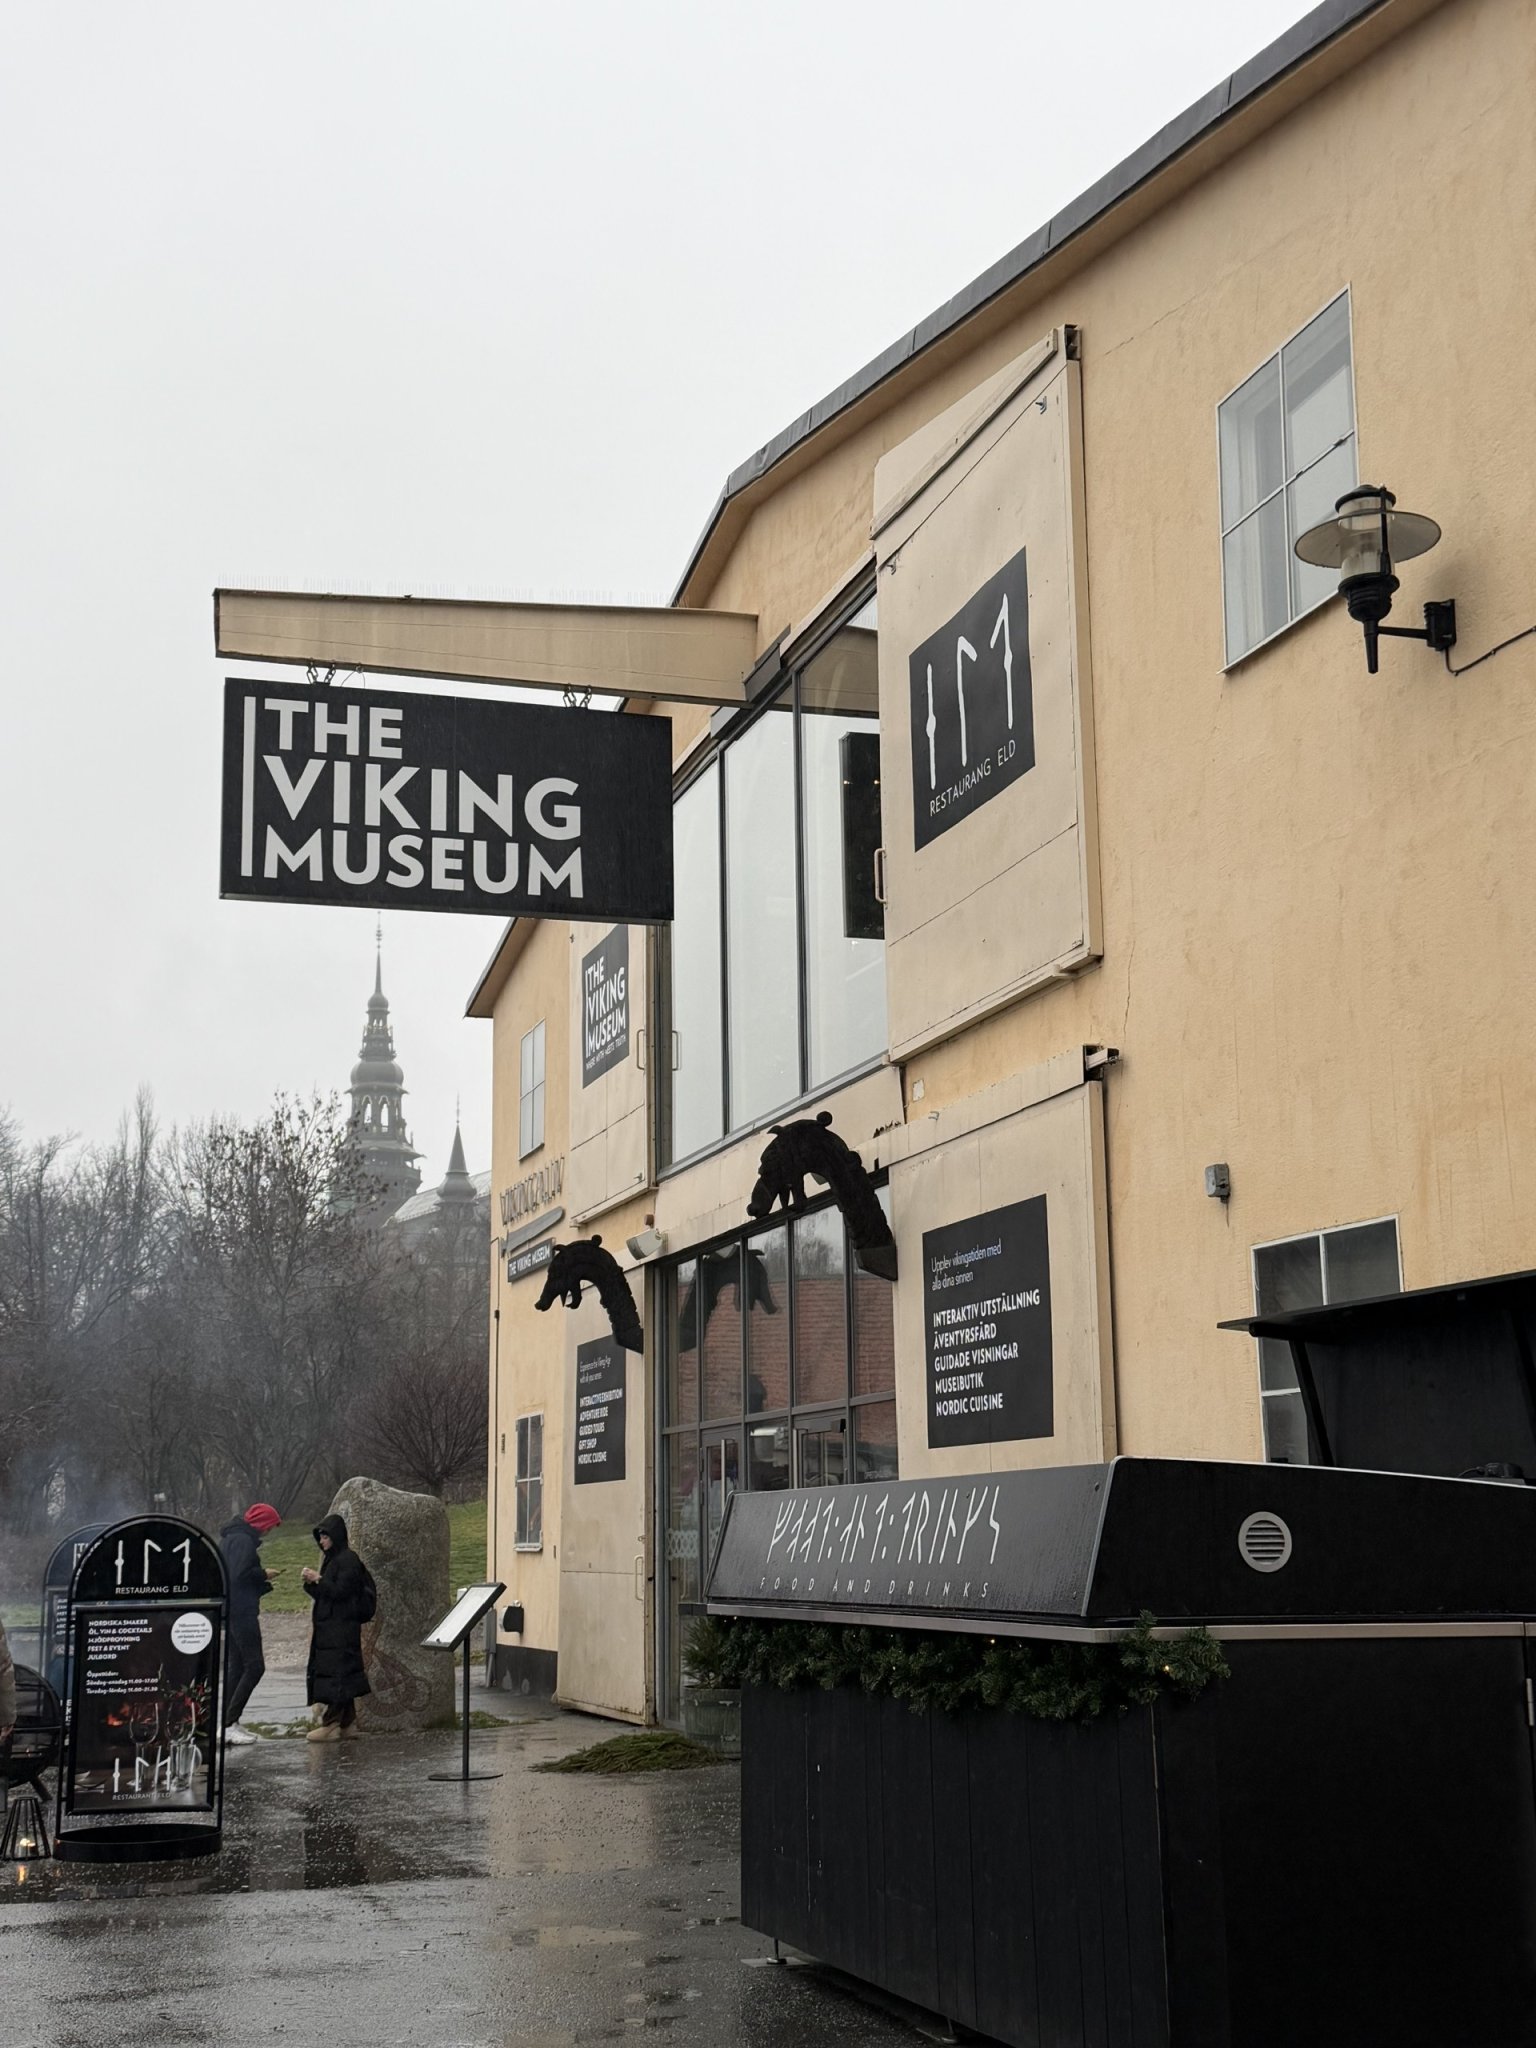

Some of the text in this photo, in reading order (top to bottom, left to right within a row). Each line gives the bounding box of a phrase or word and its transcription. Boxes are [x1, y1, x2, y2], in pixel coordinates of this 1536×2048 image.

[264, 698, 403, 759] THE
[929, 738, 1016, 817] RESTAURANG ELD
[262, 754, 581, 840] VIKING
[263, 824, 584, 898] MUSEUM
[588, 955, 605, 992] THE
[588, 966, 626, 1024] VIKING
[588, 1002, 626, 1056] MUSEUM
[508, 1244, 551, 1276] THE VIKING MUSEUM
[930, 1237, 1002, 1277] Upplev vikingatiden med
[931, 1269, 974, 1291] alla dina sinnen
[933, 1288, 1040, 1328] INTERAKTIV UTSTÄLLNING
[933, 1321, 997, 1350] ÄVENTYRSFÄRD
[934, 1341, 1019, 1372] GUIDADE VISNINGAR
[935, 1371, 984, 1396] MUSEIBUTIK
[936, 1391, 1003, 1417] NORDIC CUISINE
[578, 1451, 607, 1464] NORDIC CUISINE
[115, 1585, 189, 1594] RESTAURANG ELD
[759, 1576, 990, 1599] FOOD AND DRINKS
